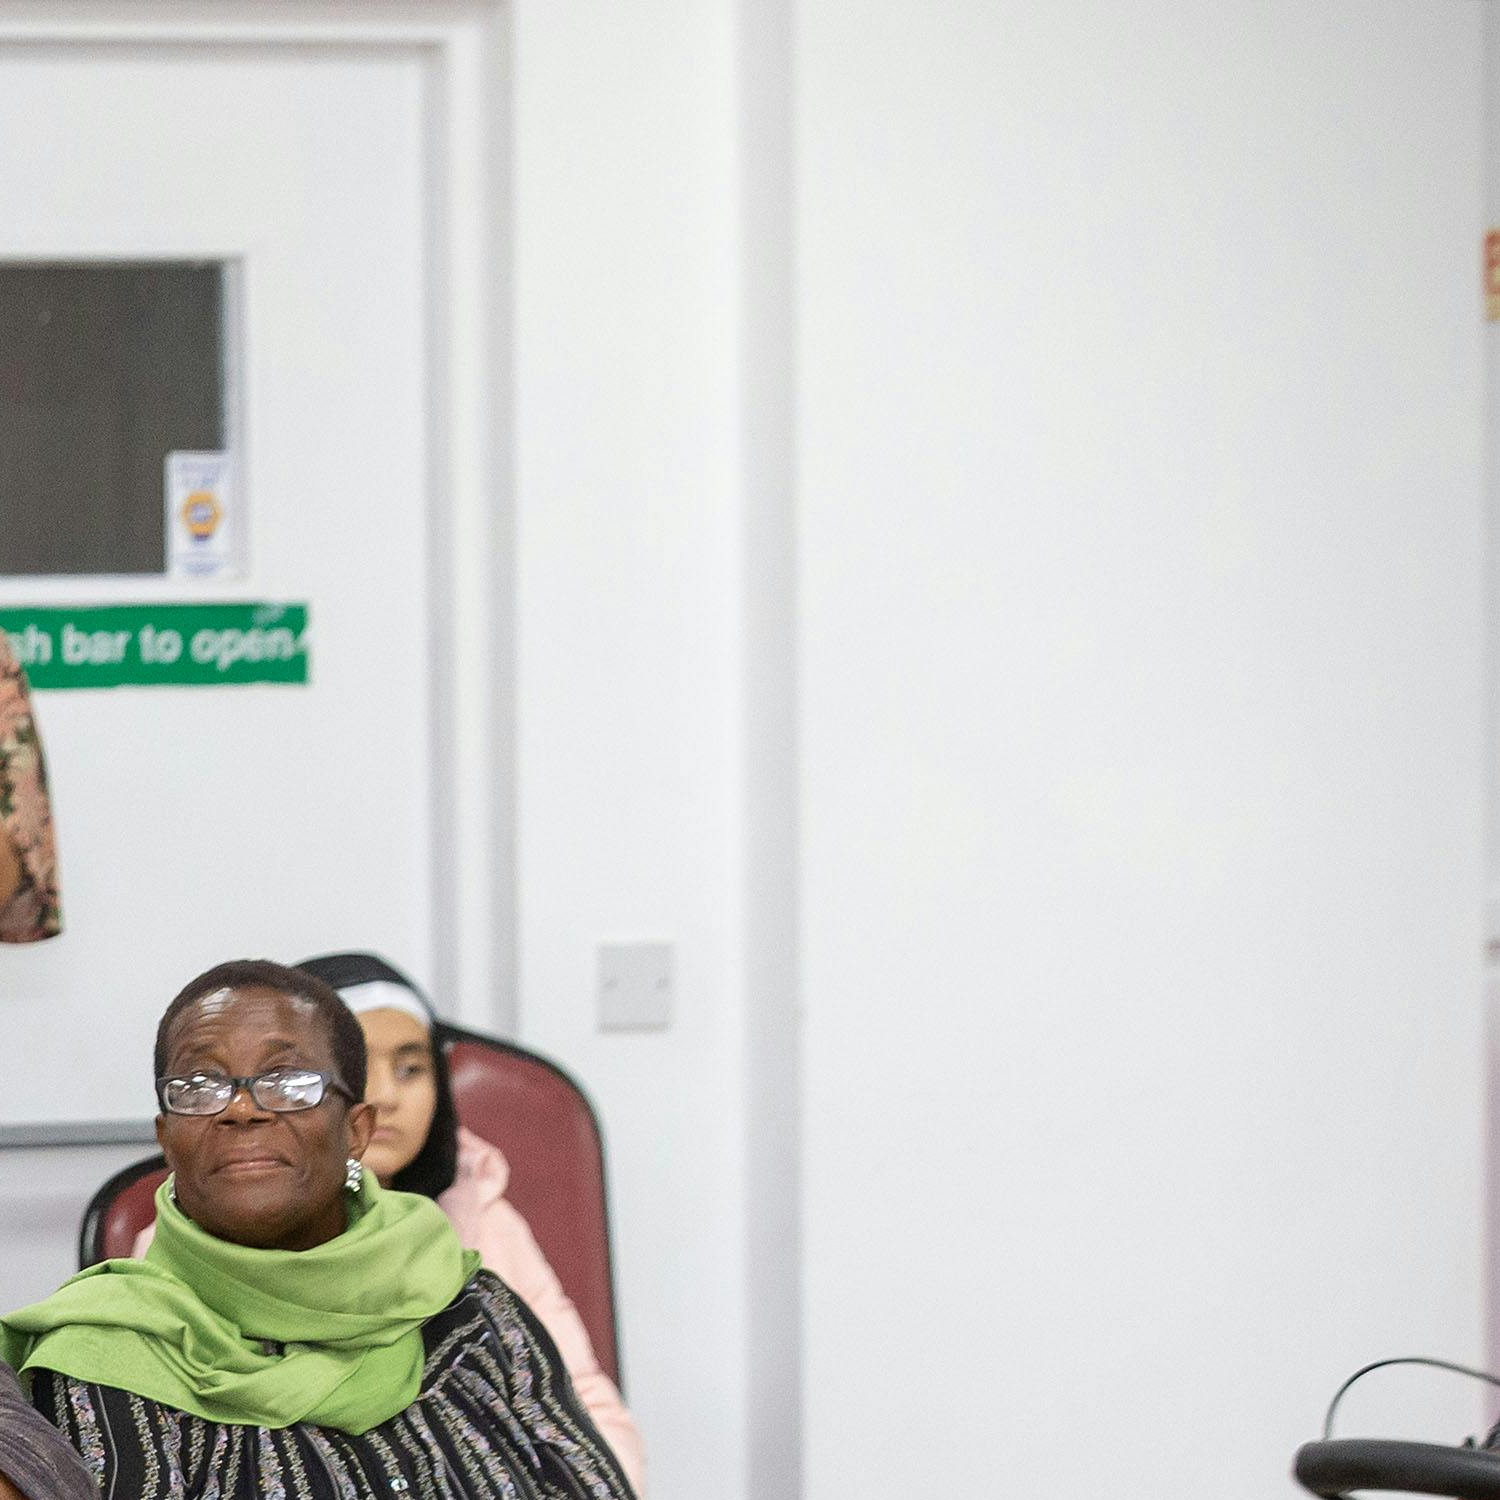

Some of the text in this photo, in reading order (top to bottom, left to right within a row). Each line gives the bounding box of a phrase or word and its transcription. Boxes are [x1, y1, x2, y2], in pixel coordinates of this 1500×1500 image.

[61, 623, 132, 665] bar
[139, 624, 183, 665] to
[190, 627, 296, 673] open
